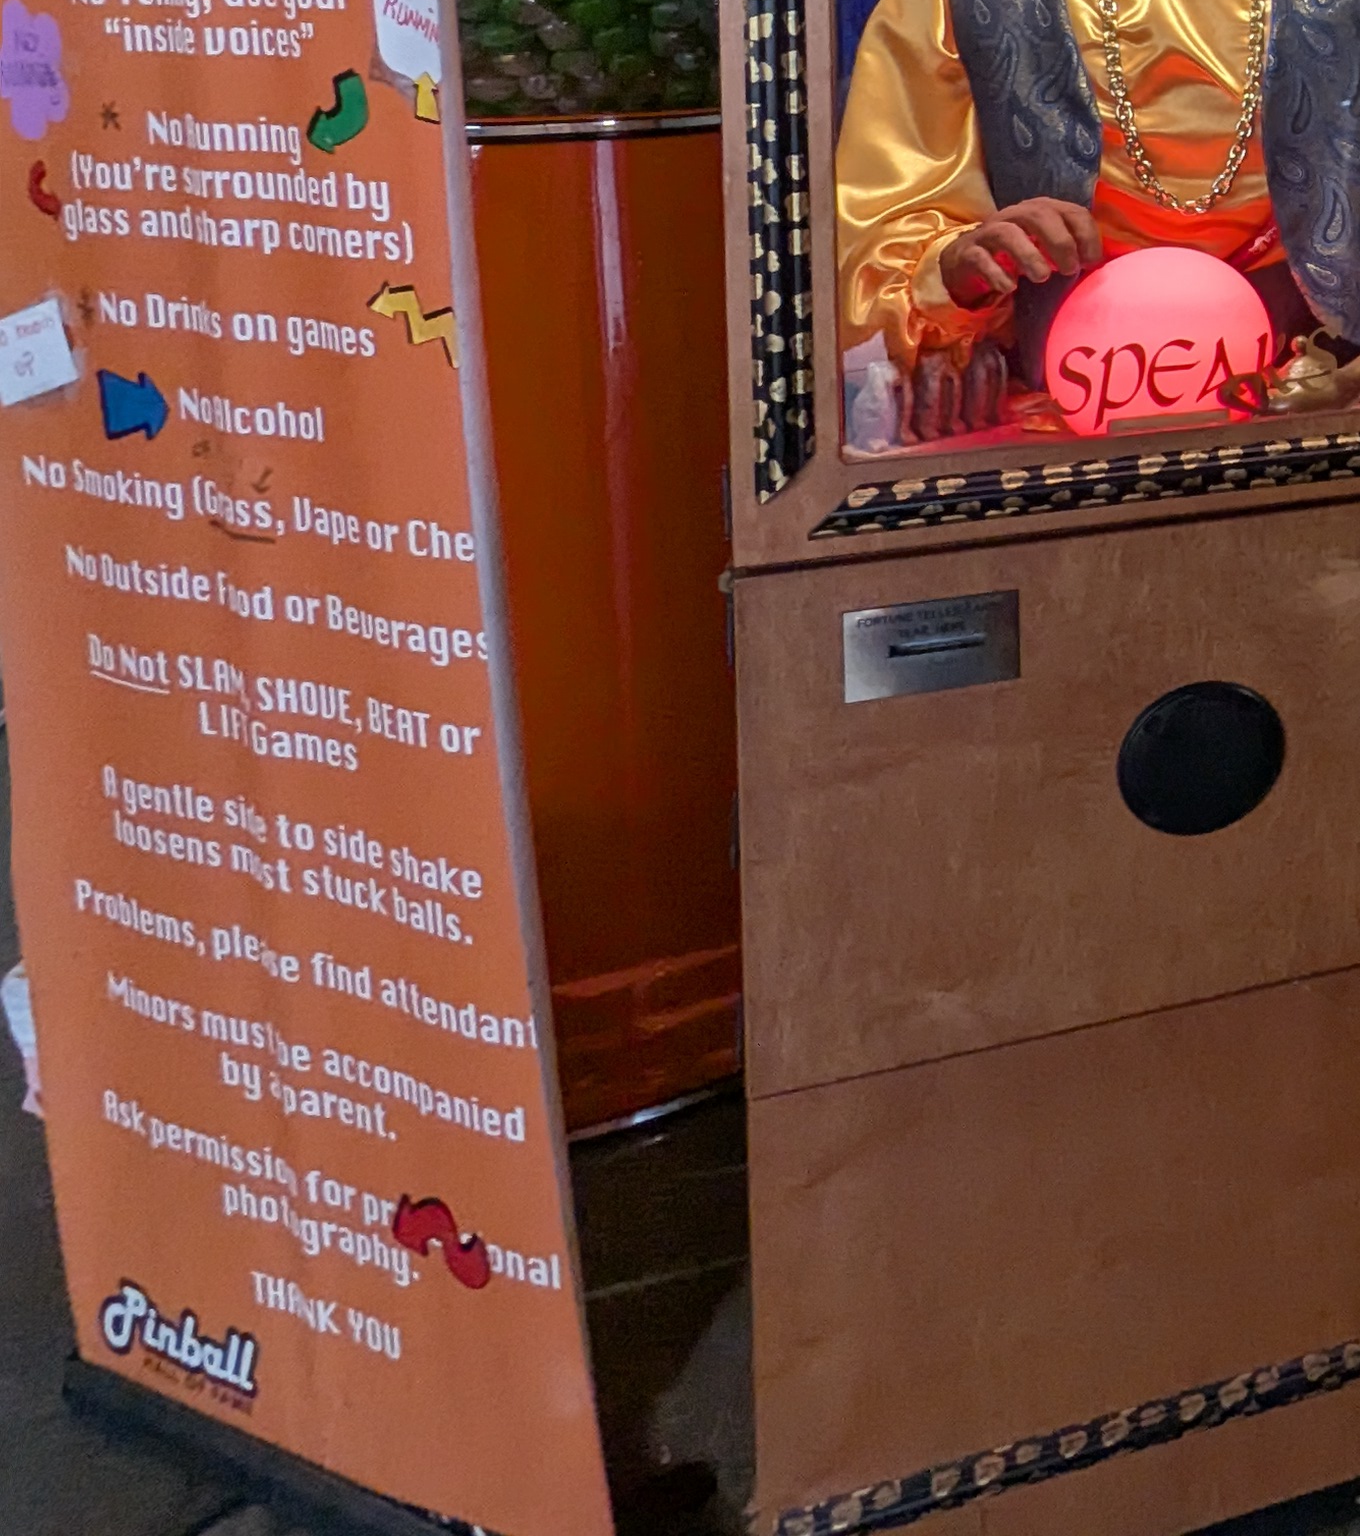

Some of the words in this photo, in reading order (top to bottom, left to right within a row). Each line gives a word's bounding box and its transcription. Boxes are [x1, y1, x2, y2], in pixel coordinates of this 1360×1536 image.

[147, 110, 183, 147] No
[62, 200, 130, 243] glass
[140, 204, 192, 240] and
[288, 220, 414, 266] corners)
[346, 173, 391, 223] by
[97, 290, 138, 327] No
[232, 311, 279, 343] on
[286, 314, 377, 358] games
[177, 386, 213, 425] No
[213, 394, 325, 444] Alcohol
[21, 454, 67, 489] No
[72, 457, 184, 522] Smoking
[292, 496, 361, 547] Vape
[366, 520, 400, 554] or
[65, 543, 98, 582] No
[100, 553, 211, 604] Outside
[285, 593, 319, 626] or
[325, 592, 490, 667] Beverages
[87, 632, 115, 672] Do
[119, 646, 170, 686] Not
[256, 676, 363, 735] SHOVE,
[366, 696, 430, 749] BEAT
[439, 722, 482, 756] or
[199, 700, 249, 747] LIFT
[250, 719, 359, 772] Games
[103, 765, 117, 799] A
[122, 777, 215, 824] gentle
[275, 813, 315, 853] to
[324, 824, 384, 870] side
[391, 845, 483, 901] shake
[113, 810, 223, 869] loosens
[303, 864, 389, 917] stuck
[392, 887, 475, 946] balls.
[75, 878, 206, 957] Problems,
[310, 951, 373, 1002] find
[106, 970, 196, 1032] Minors
[201, 1007, 276, 1056] must
[322, 1049, 528, 1145] accompanied
[219, 1053, 263, 1102] by
[282, 1081, 398, 1142] parent.
[102, 1088, 147, 1135] Ask
[147, 1115, 300, 1197] permission
[303, 1169, 357, 1213] for
[101, 1284, 258, 1396] Pinball
[249, 1268, 341, 1339] THANK
[346, 1305, 402, 1363] YOU
